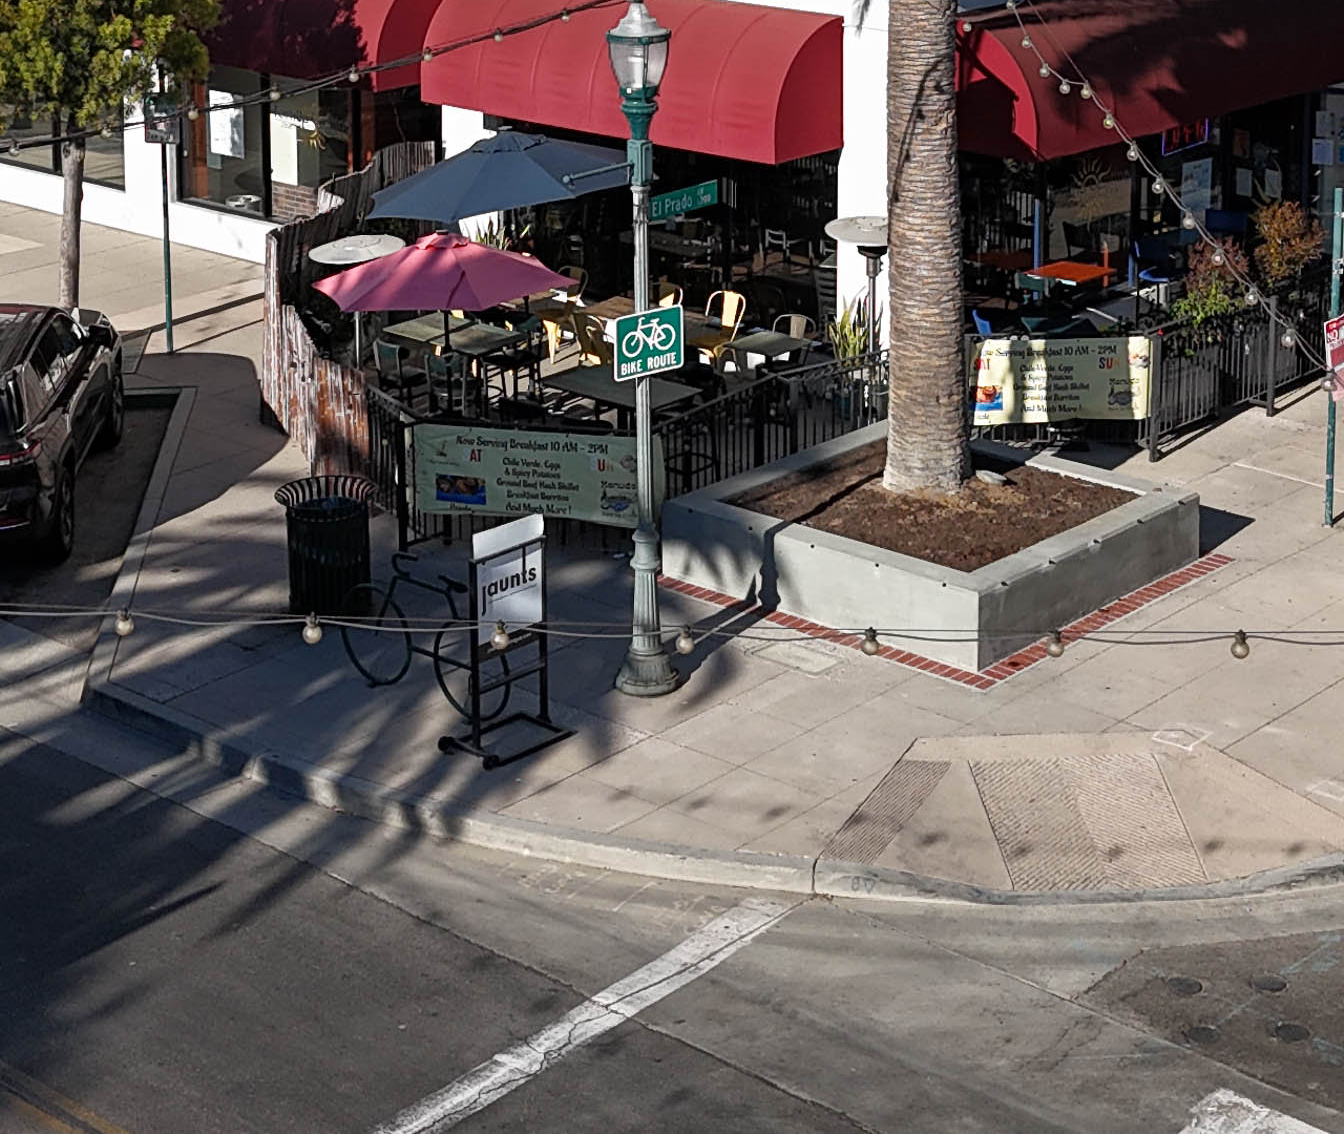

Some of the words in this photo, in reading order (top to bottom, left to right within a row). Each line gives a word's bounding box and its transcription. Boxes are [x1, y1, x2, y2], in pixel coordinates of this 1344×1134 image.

[652, 201, 662, 218] El
[664, 193, 693, 214] Prado
[1064, 346, 1074, 356] 10
[1075, 346, 1089, 355] AM
[620, 359, 643, 376] BIKE
[647, 351, 677, 371] ROUTE
[476, 436, 508, 451] Serving
[509, 439, 549, 452] Breakfast
[550, 441, 560, 452] 10
[561, 442, 579, 453] AM
[522, 503, 544, 515] Much
[481, 546, 537, 617] jaunts
